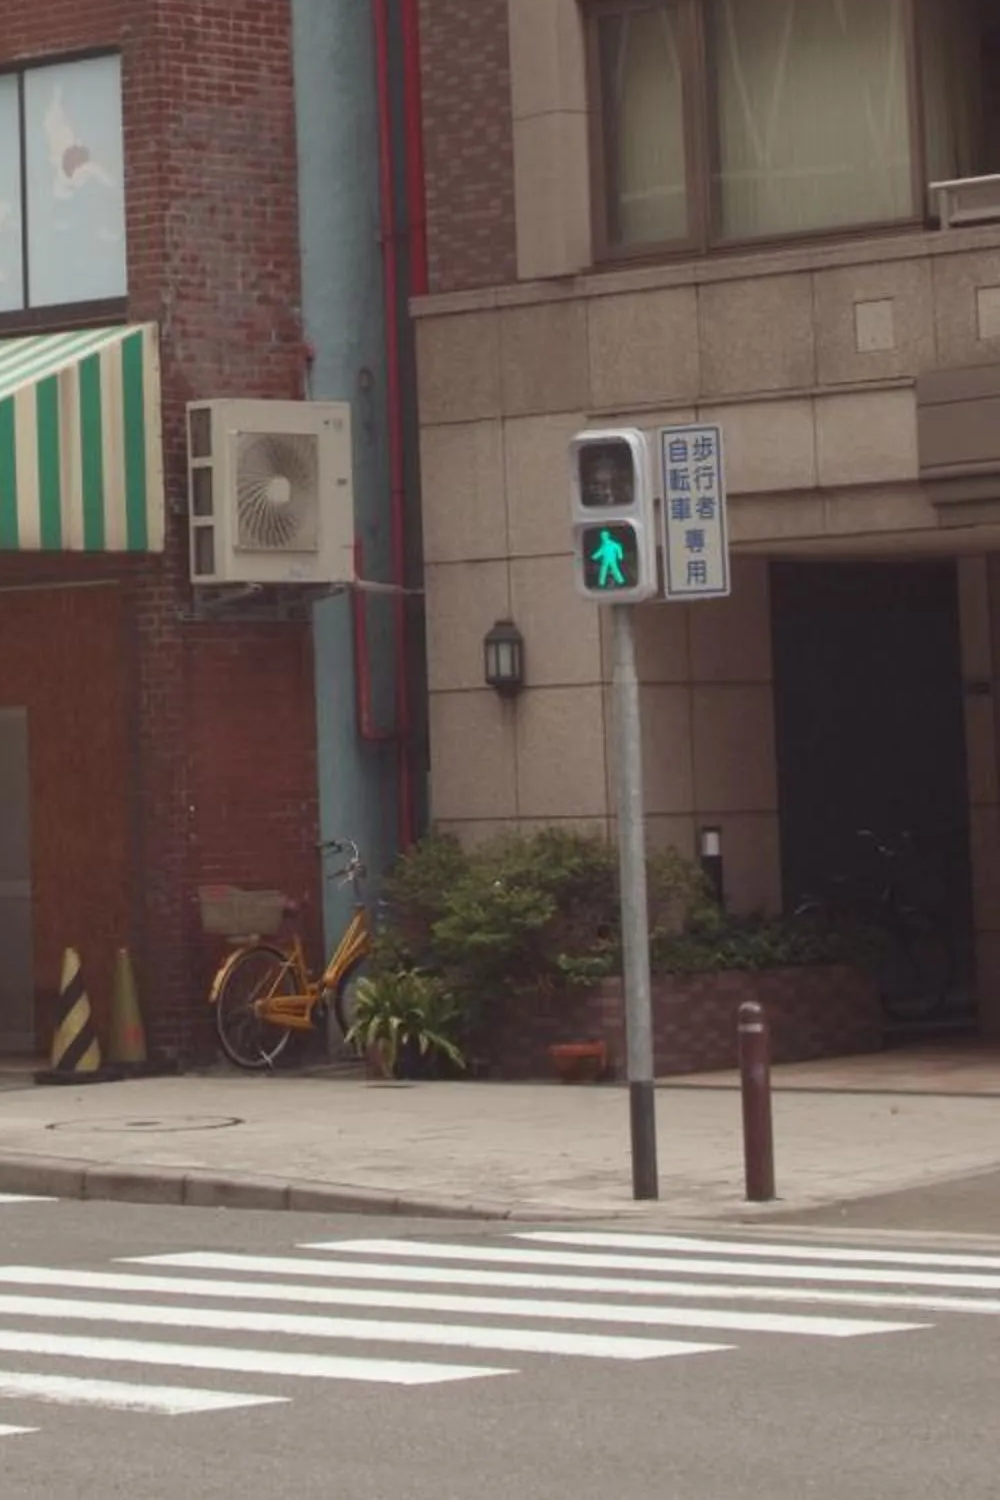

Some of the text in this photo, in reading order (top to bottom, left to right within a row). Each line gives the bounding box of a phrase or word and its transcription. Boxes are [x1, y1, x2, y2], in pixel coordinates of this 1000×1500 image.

[669, 438, 691, 521] 自転車
[693, 436, 716, 520] 歩行者
[685, 528, 707, 586] 専用
